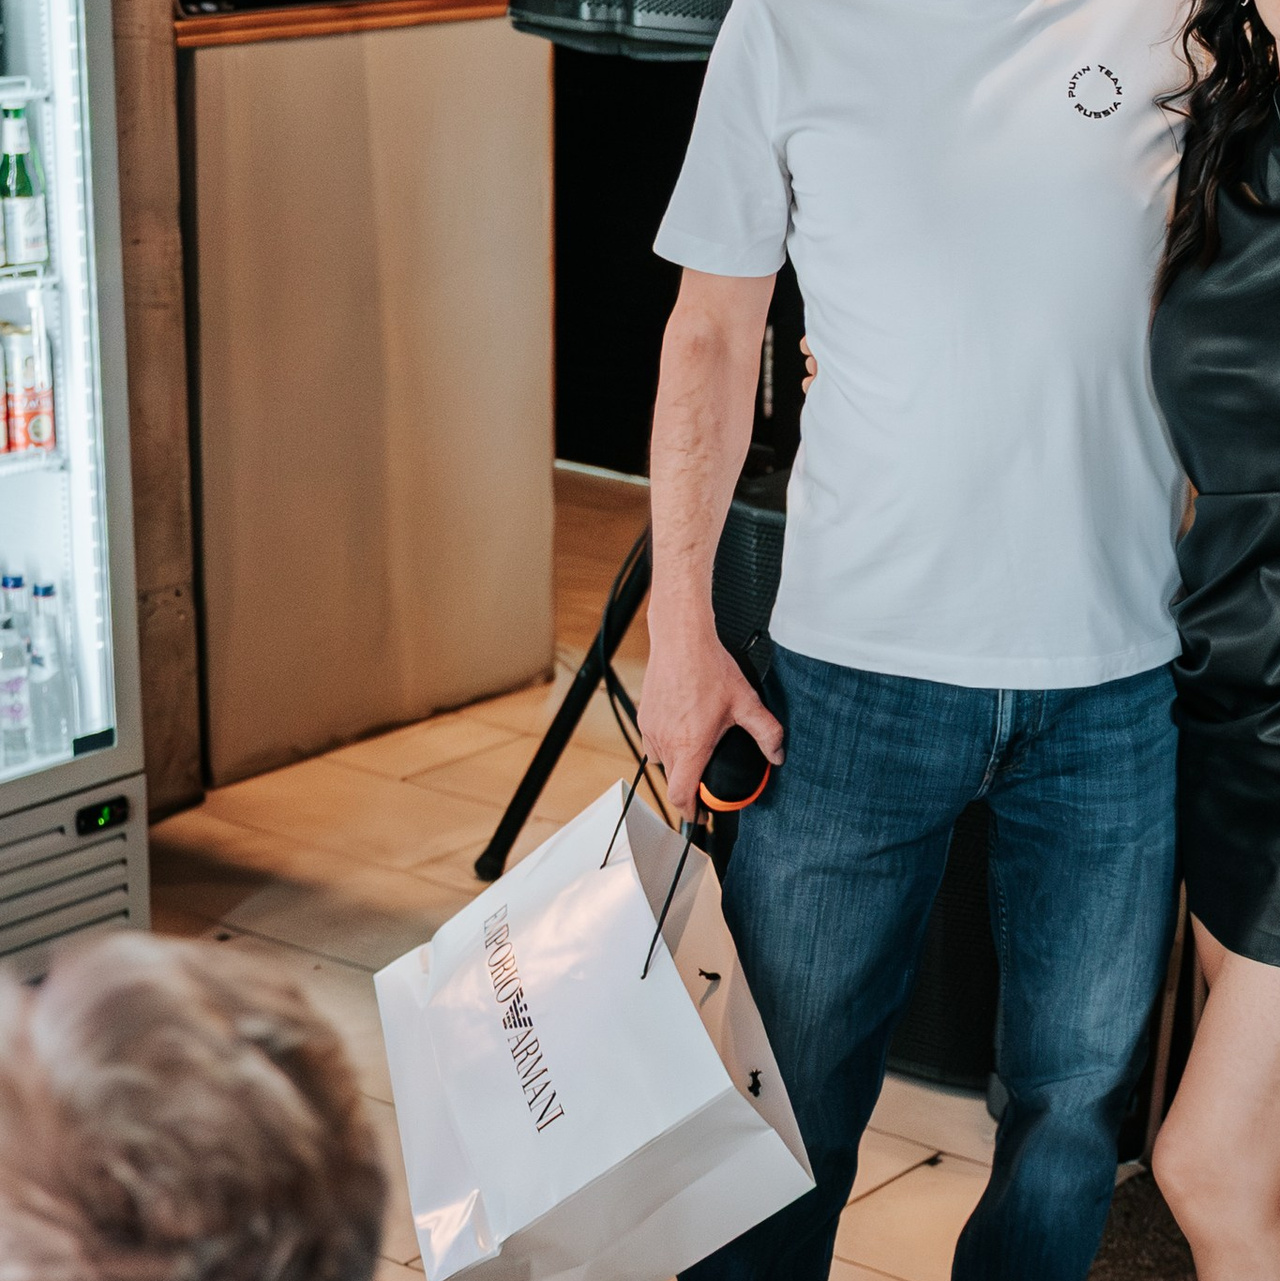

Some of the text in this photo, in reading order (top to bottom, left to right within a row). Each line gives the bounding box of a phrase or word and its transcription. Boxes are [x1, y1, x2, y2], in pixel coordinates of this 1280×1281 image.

[1068, 64, 1122, 98] PUTIN TEAM
[1074, 101, 1121, 119] RUSSIA
[484, 903, 565, 1133] EMPORIO ARMANI
